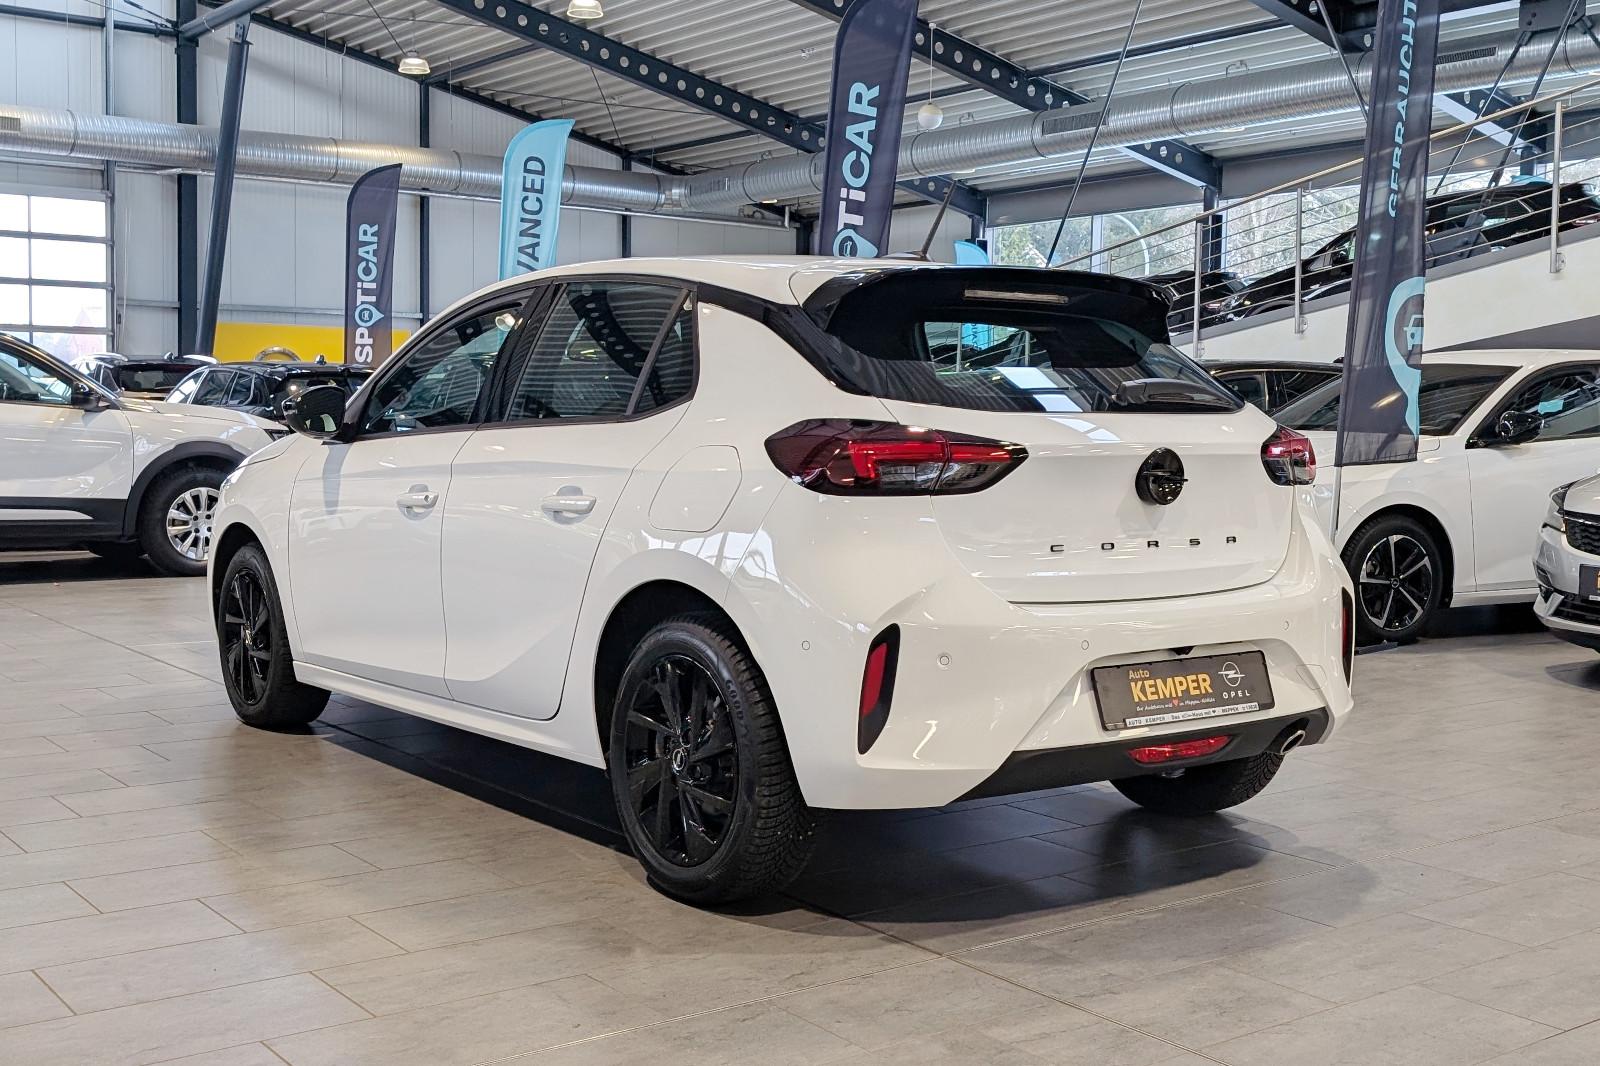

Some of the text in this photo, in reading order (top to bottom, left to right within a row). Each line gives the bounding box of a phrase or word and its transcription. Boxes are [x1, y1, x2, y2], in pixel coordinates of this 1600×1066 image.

[1050, 536, 1237, 553] CORSA
[1129, 669, 1150, 680] Auto
[1130, 673, 1213, 702] KEMPER
[1222, 689, 1252, 699] OPEL
